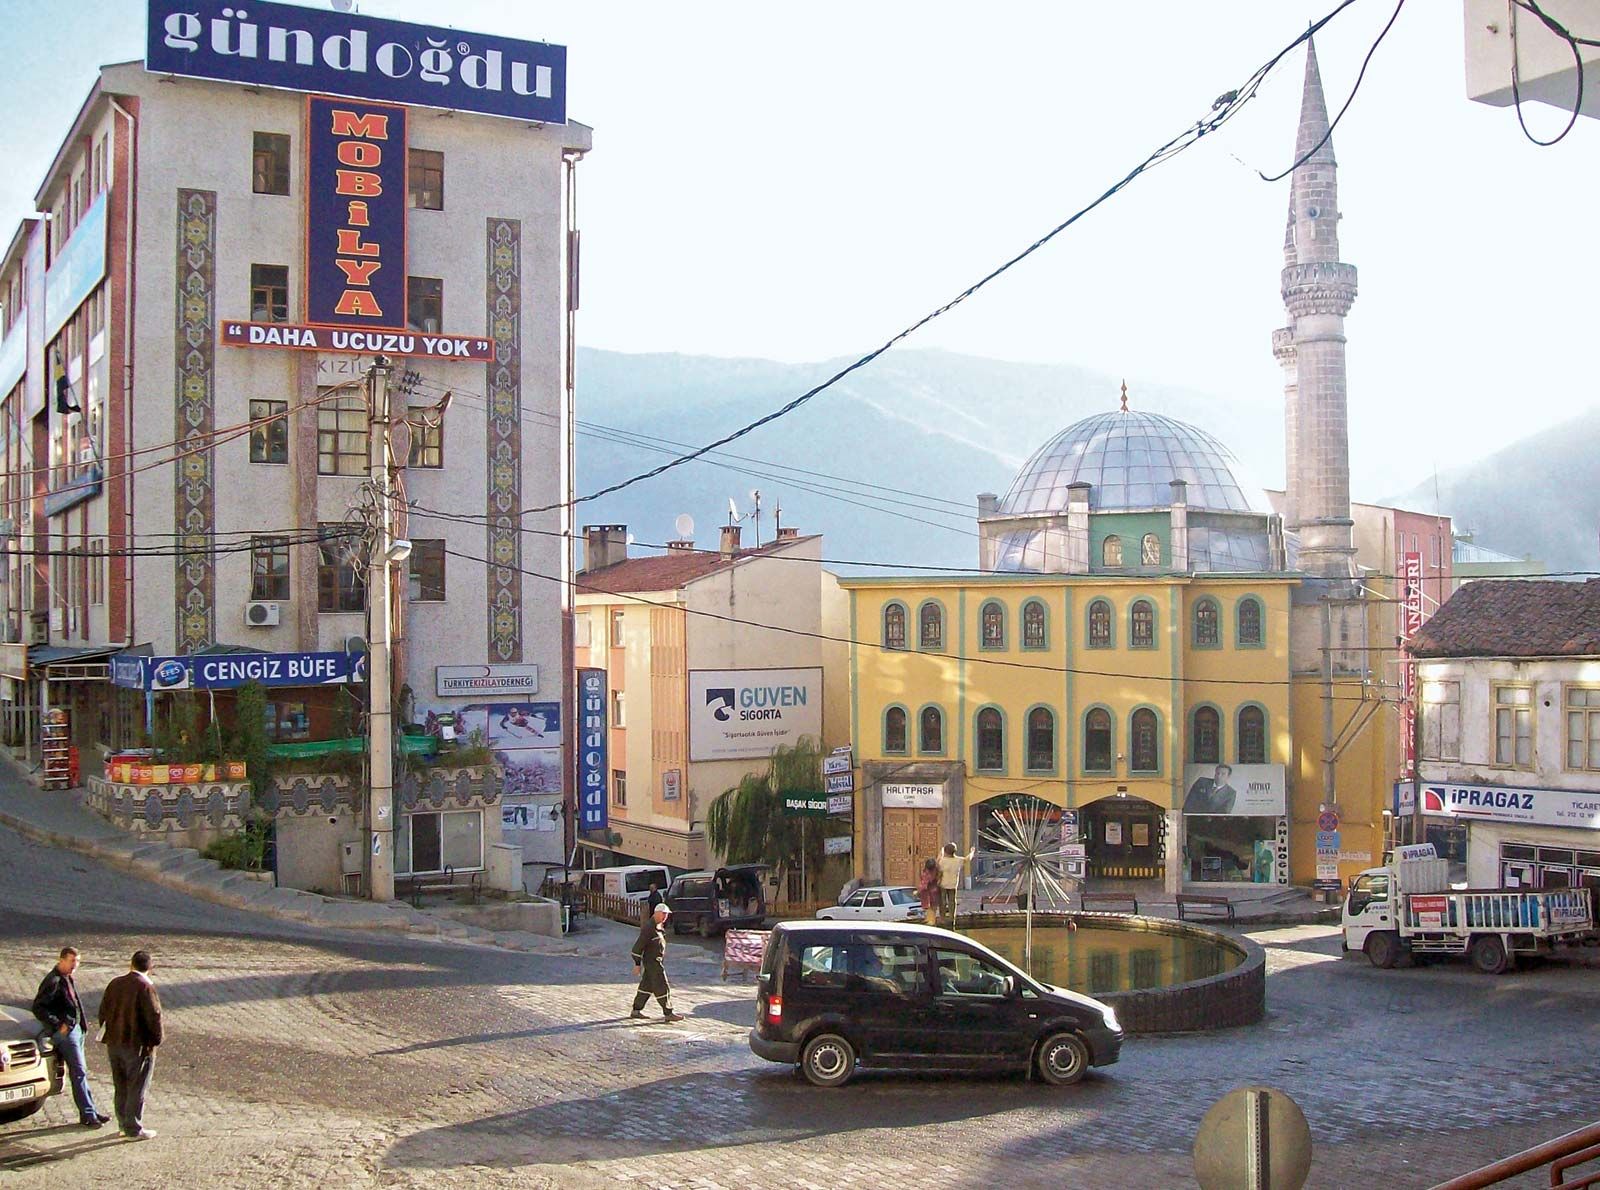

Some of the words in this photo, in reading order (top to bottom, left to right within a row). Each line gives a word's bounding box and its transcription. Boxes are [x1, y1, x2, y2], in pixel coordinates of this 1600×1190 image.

[164, 8, 552, 98] gündoğdu
[332, 332, 415, 354] UCUZU
[160, 666, 181, 678] EFES
[203, 656, 282, 681] CENGİZ
[288, 658, 336, 678] BÜFE
[740, 686, 806, 708] GÜVEN
[786, 799, 807, 810] BAŞAK
